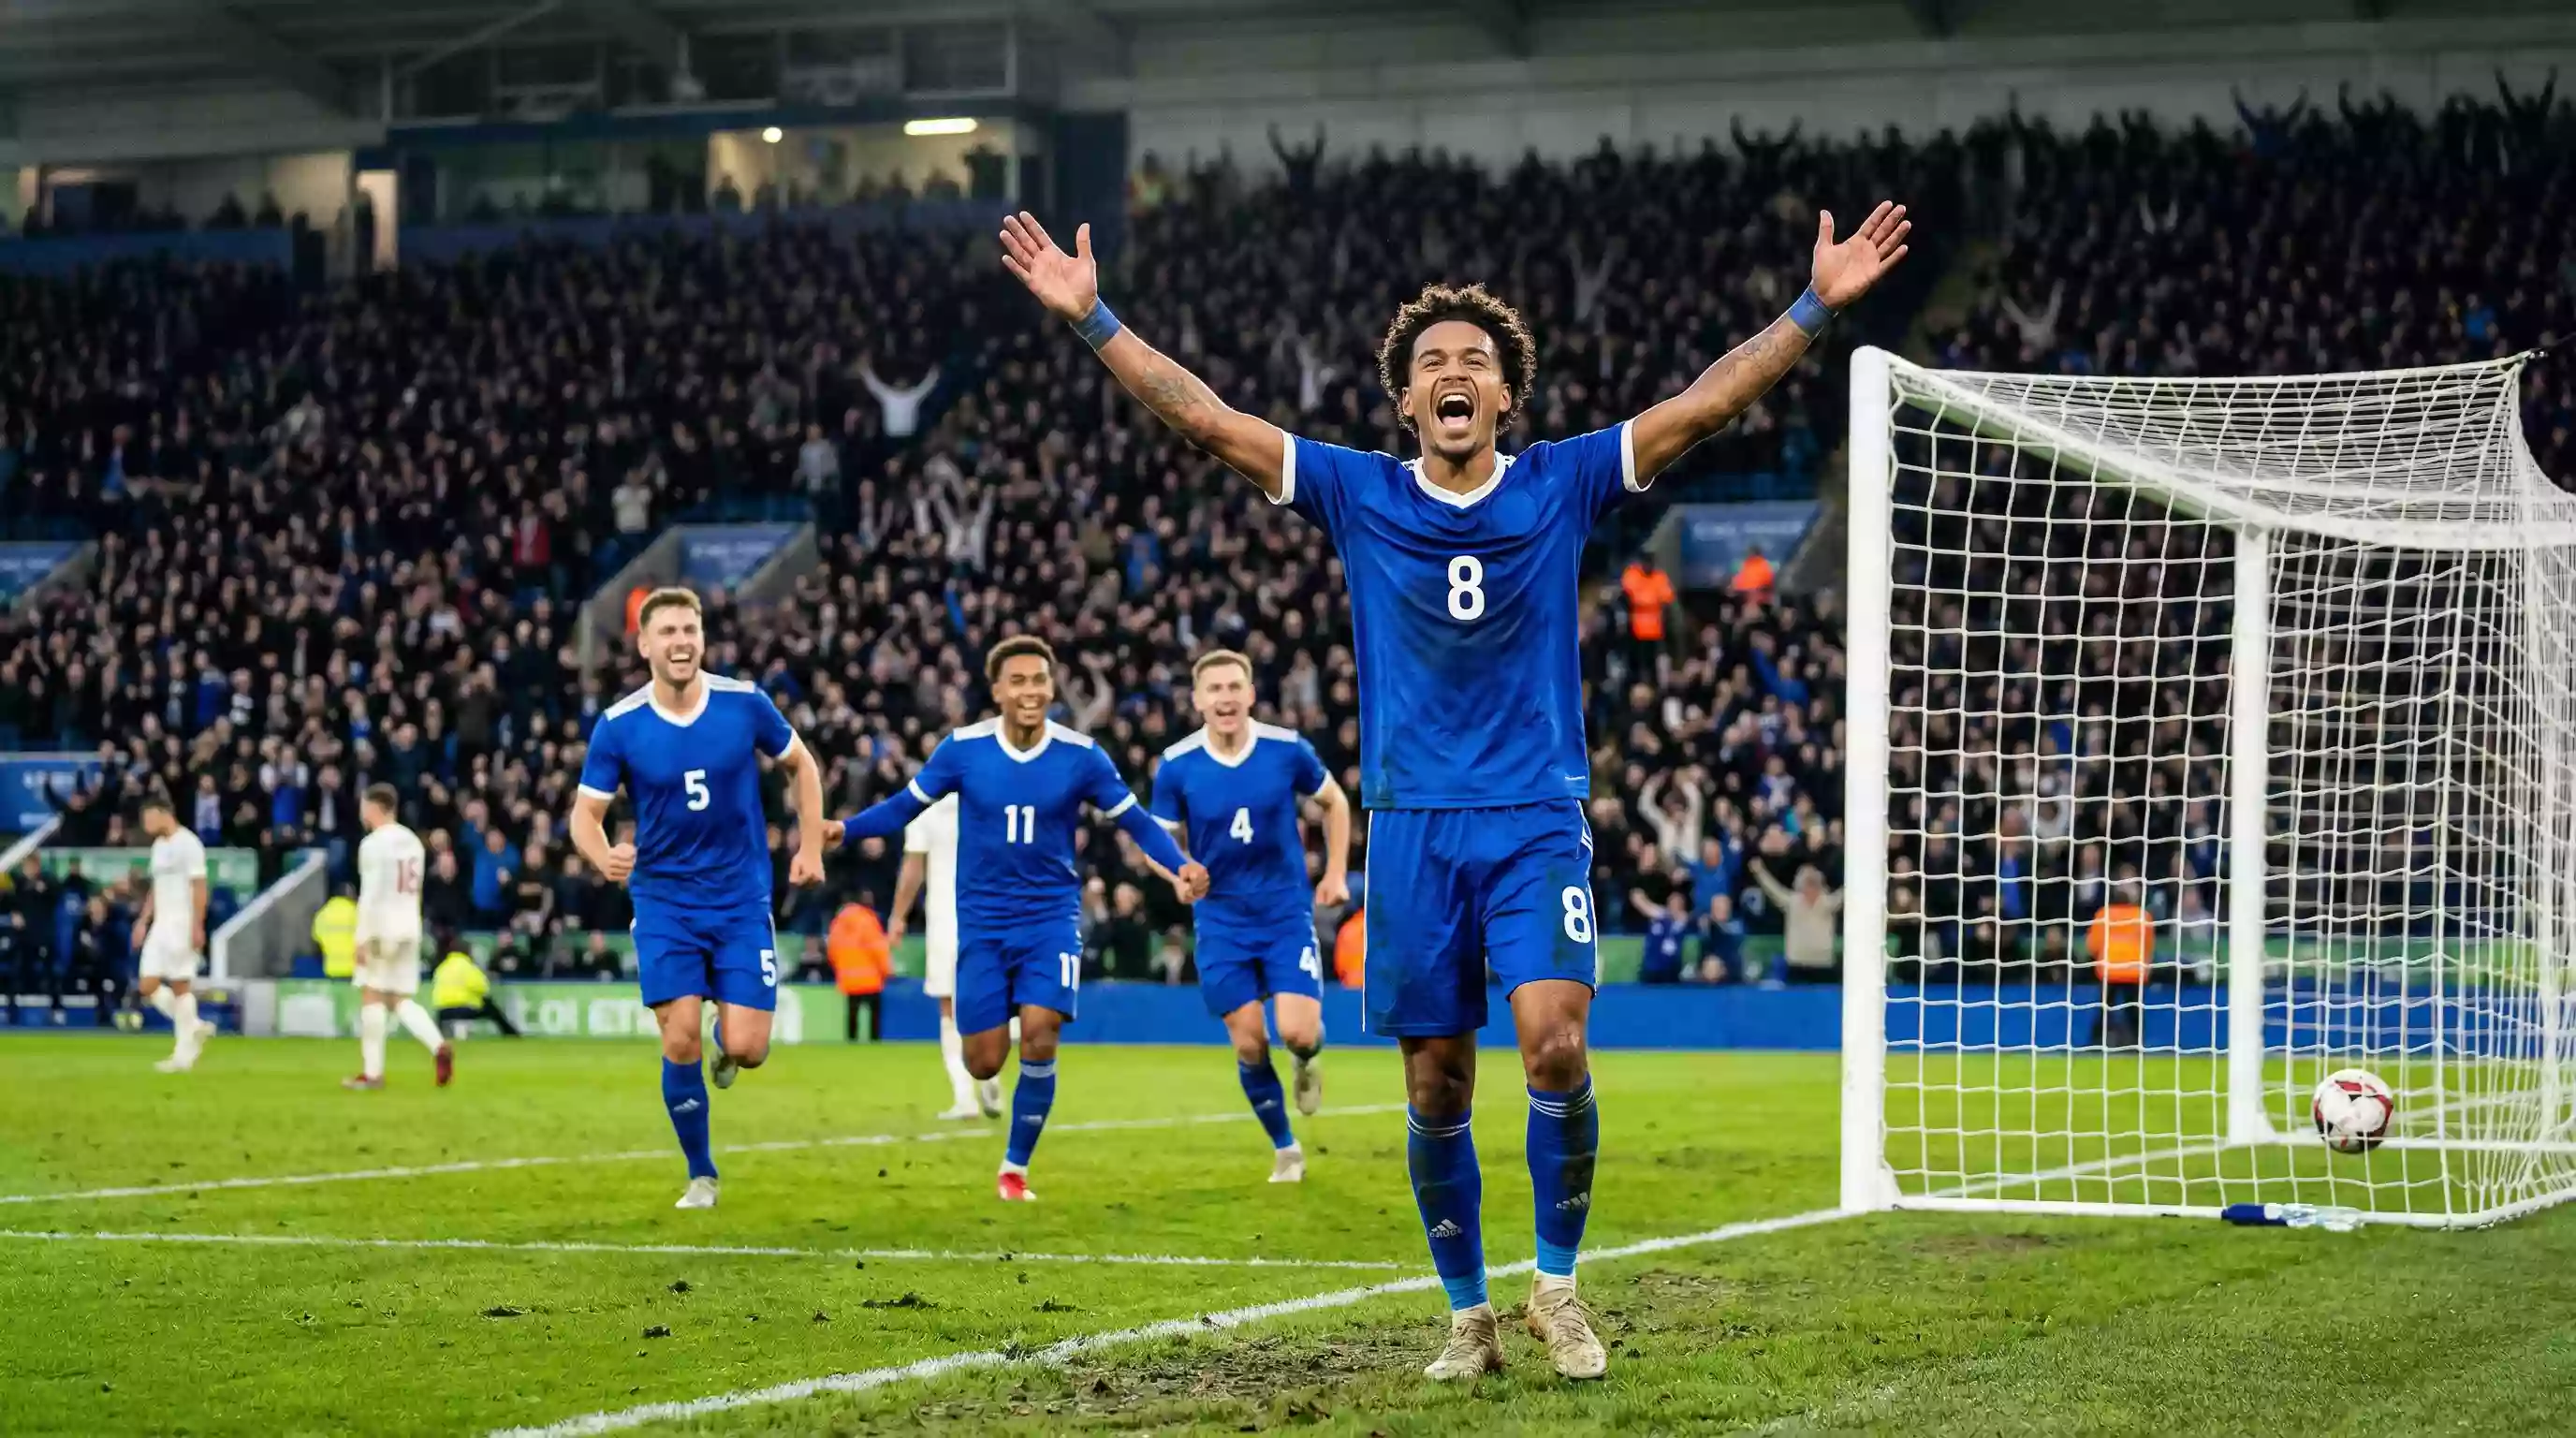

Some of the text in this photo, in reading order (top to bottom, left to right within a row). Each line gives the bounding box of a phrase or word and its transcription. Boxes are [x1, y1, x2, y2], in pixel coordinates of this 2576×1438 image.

[1447, 555, 1485, 621] 8
[683, 769, 710, 811] 5
[1004, 804, 1035, 844] 11
[1230, 807, 1254, 844] 4
[1561, 886, 1591, 944] 8
[760, 948, 776, 987] 5
[1059, 951, 1081, 991] 11
[1299, 945, 1319, 979] 4
